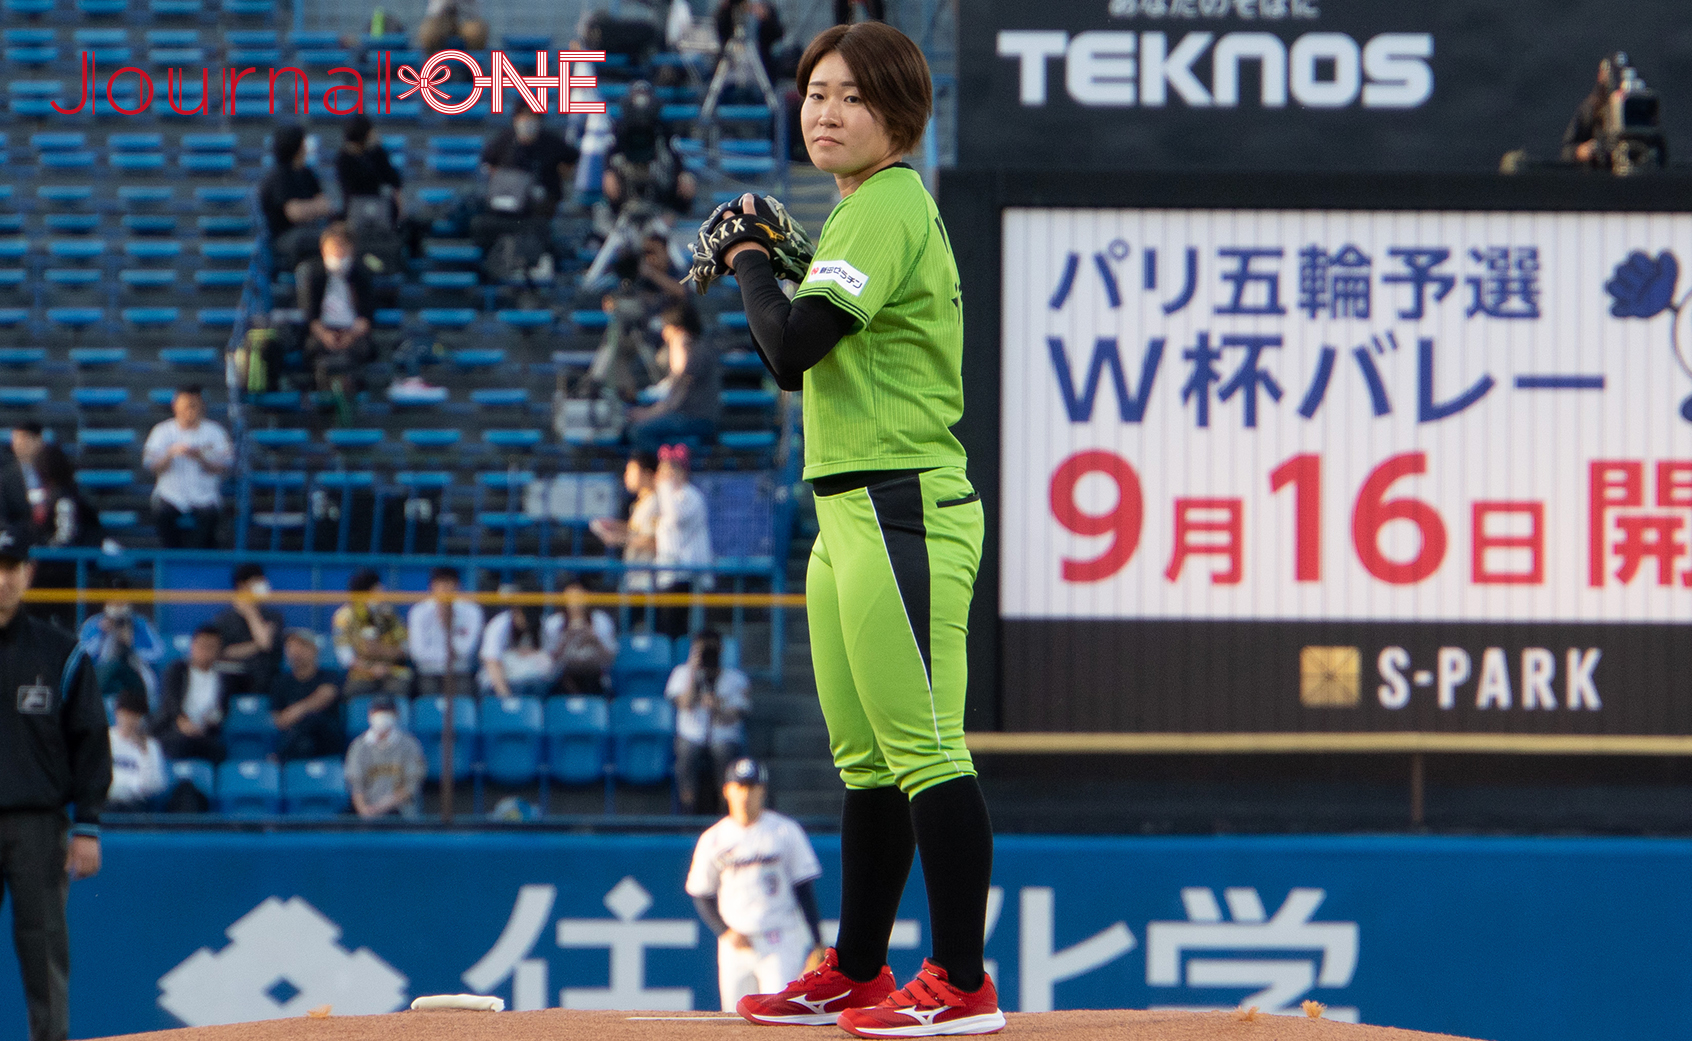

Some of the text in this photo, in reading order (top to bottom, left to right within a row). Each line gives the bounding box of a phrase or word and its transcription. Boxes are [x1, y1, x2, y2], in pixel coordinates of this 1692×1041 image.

[997, 30, 1434, 108] TEKNOS
[1047, 238, 1543, 321] パリ五輪予選
[1045, 330, 1606, 429] W杯バレー
[1377, 646, 1602, 710] S-PARK
